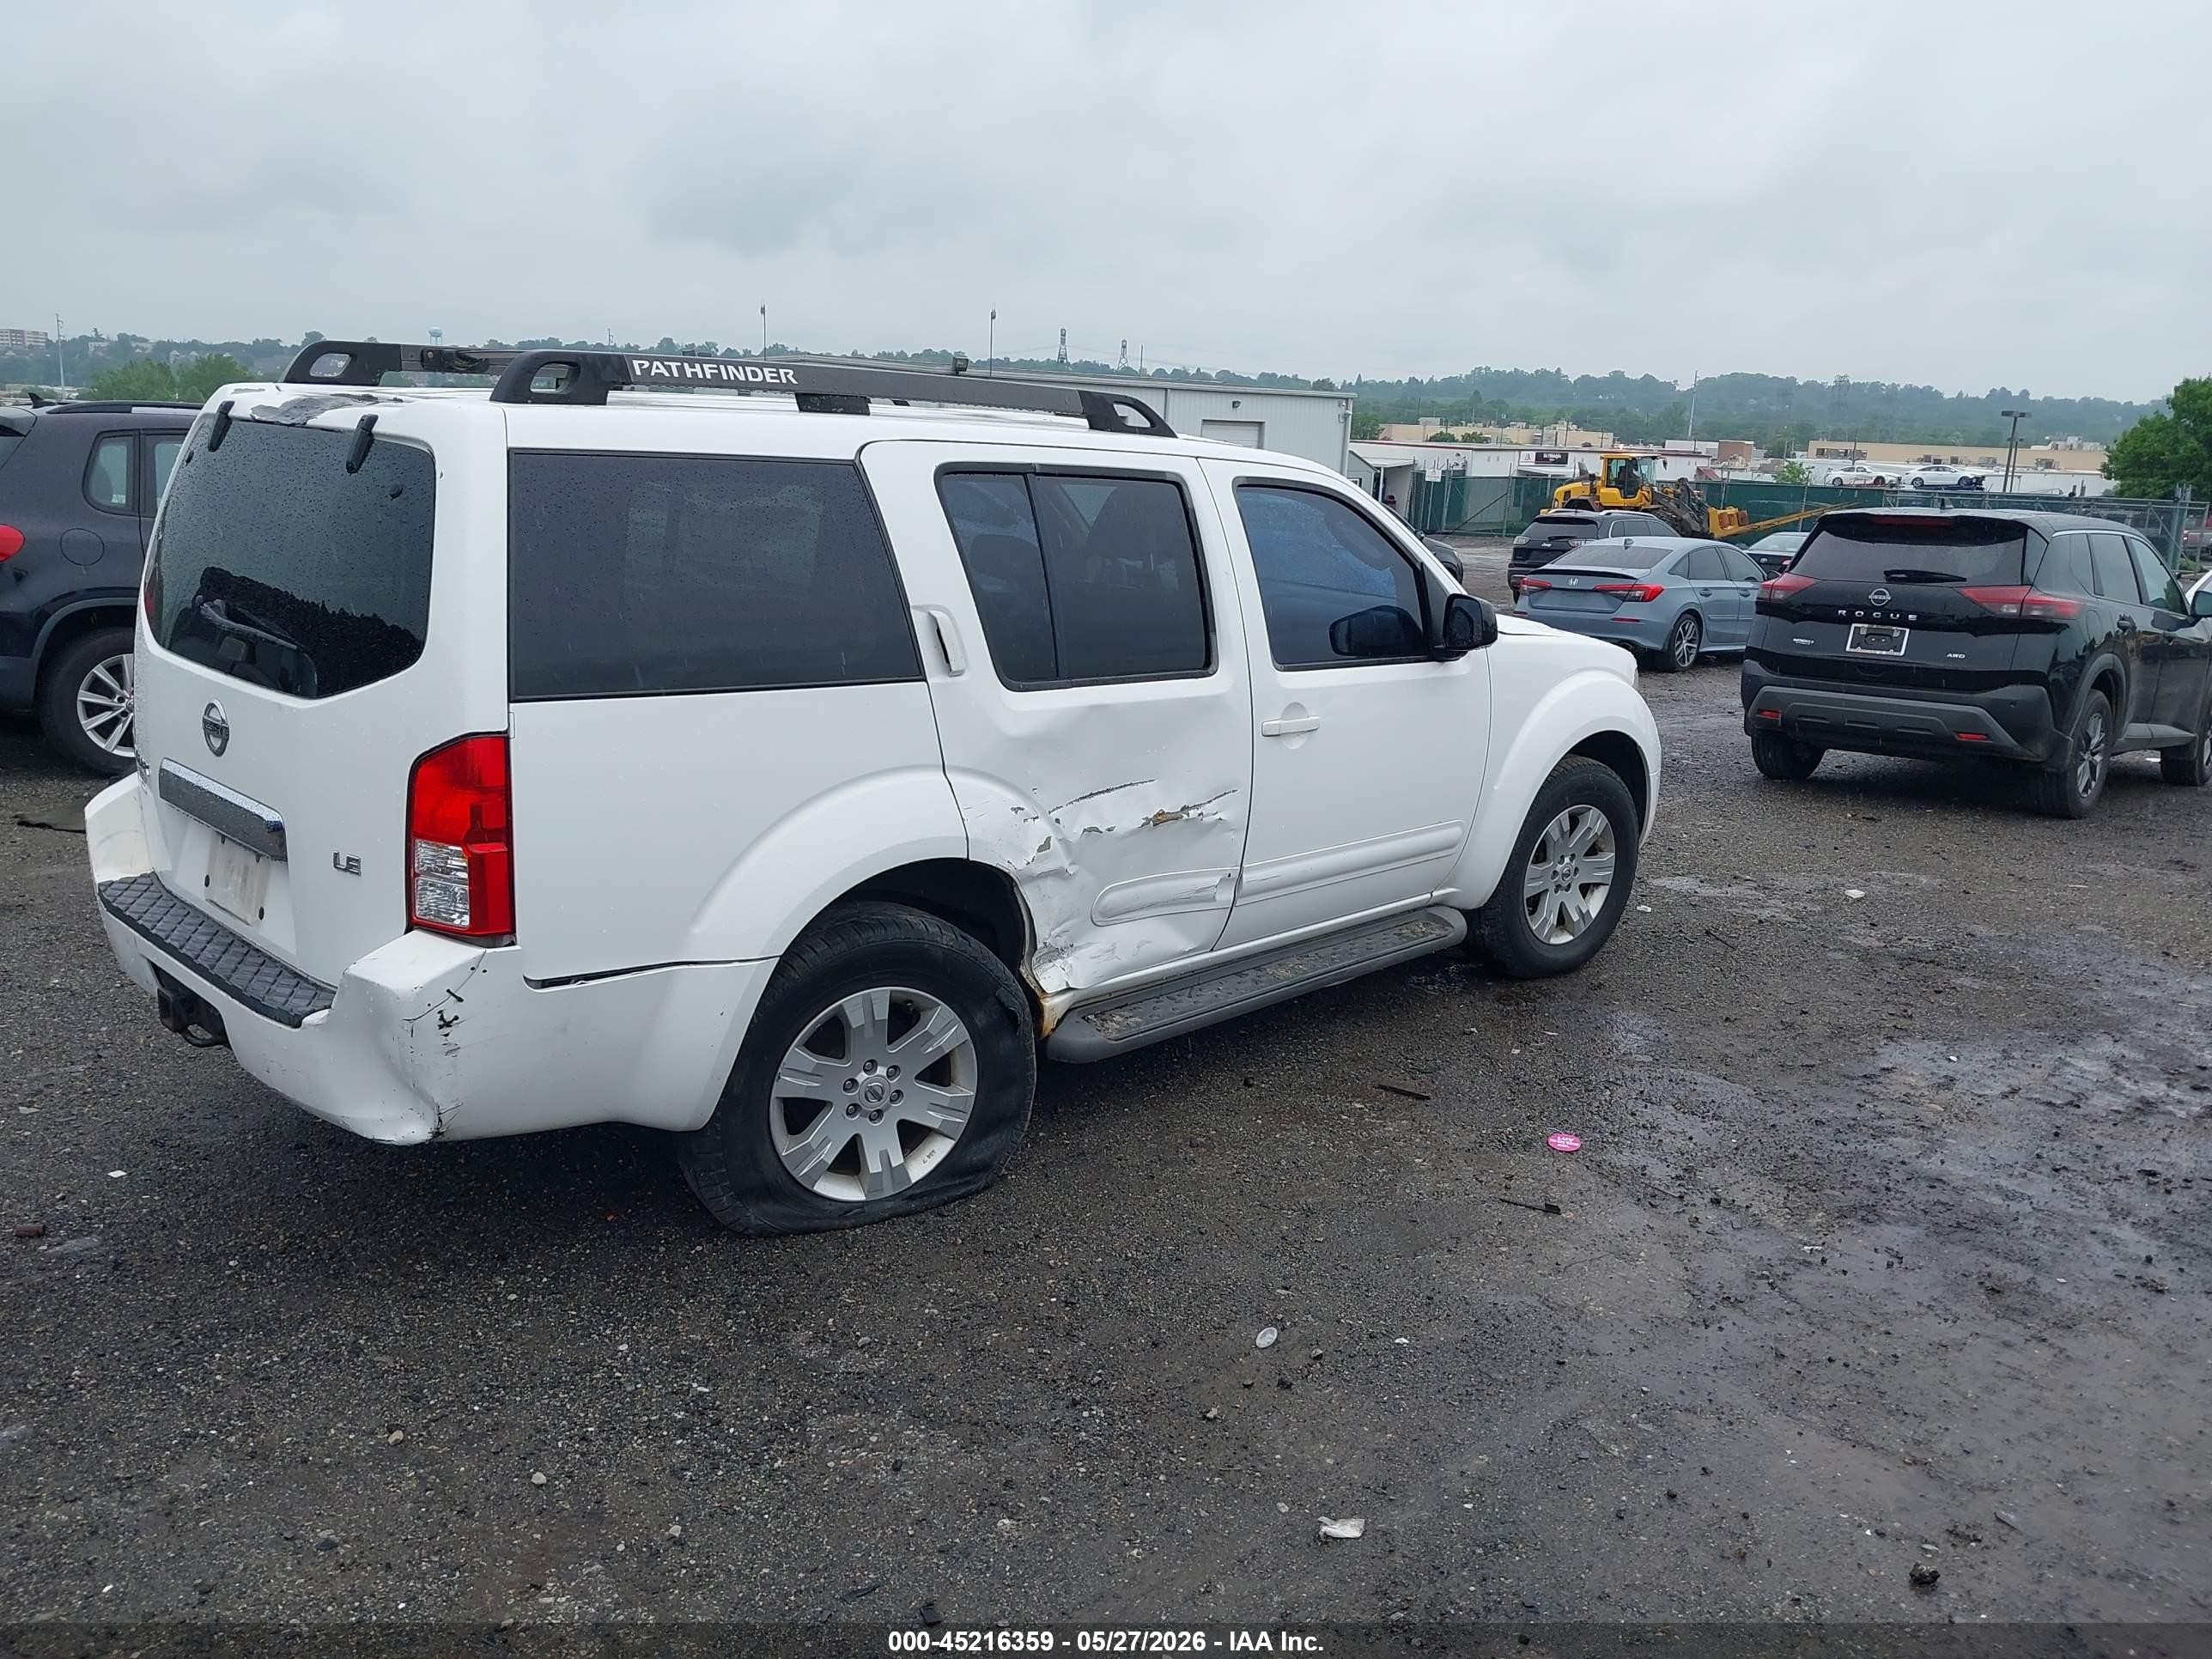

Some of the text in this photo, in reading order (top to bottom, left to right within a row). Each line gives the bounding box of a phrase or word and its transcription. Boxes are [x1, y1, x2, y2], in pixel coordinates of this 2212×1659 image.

[632, 359, 799, 385] PATHFINDER
[1838, 609, 1917, 621] ROGUE
[333, 851, 362, 876] LE
